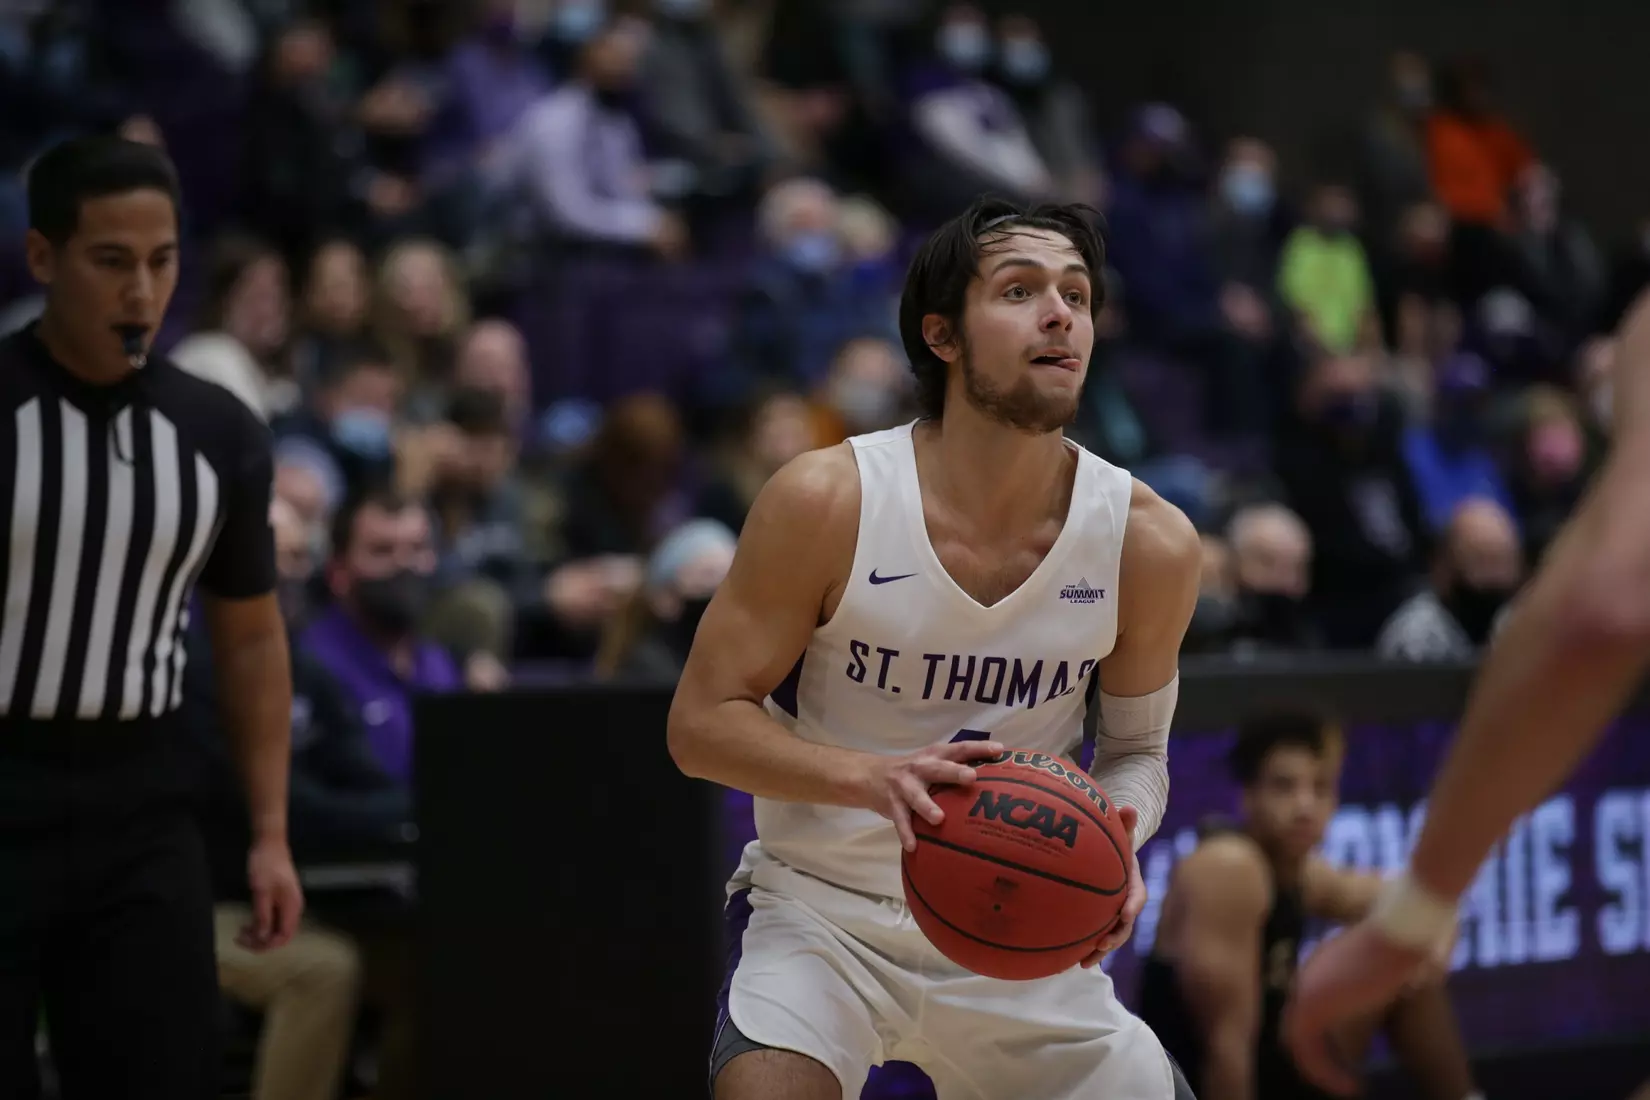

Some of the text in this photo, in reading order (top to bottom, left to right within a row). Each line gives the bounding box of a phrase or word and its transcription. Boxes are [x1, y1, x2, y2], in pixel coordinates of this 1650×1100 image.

[1059, 589, 1106, 600] SUMMIT
[846, 639, 901, 694] ST.
[968, 790, 1080, 849] NCAA
